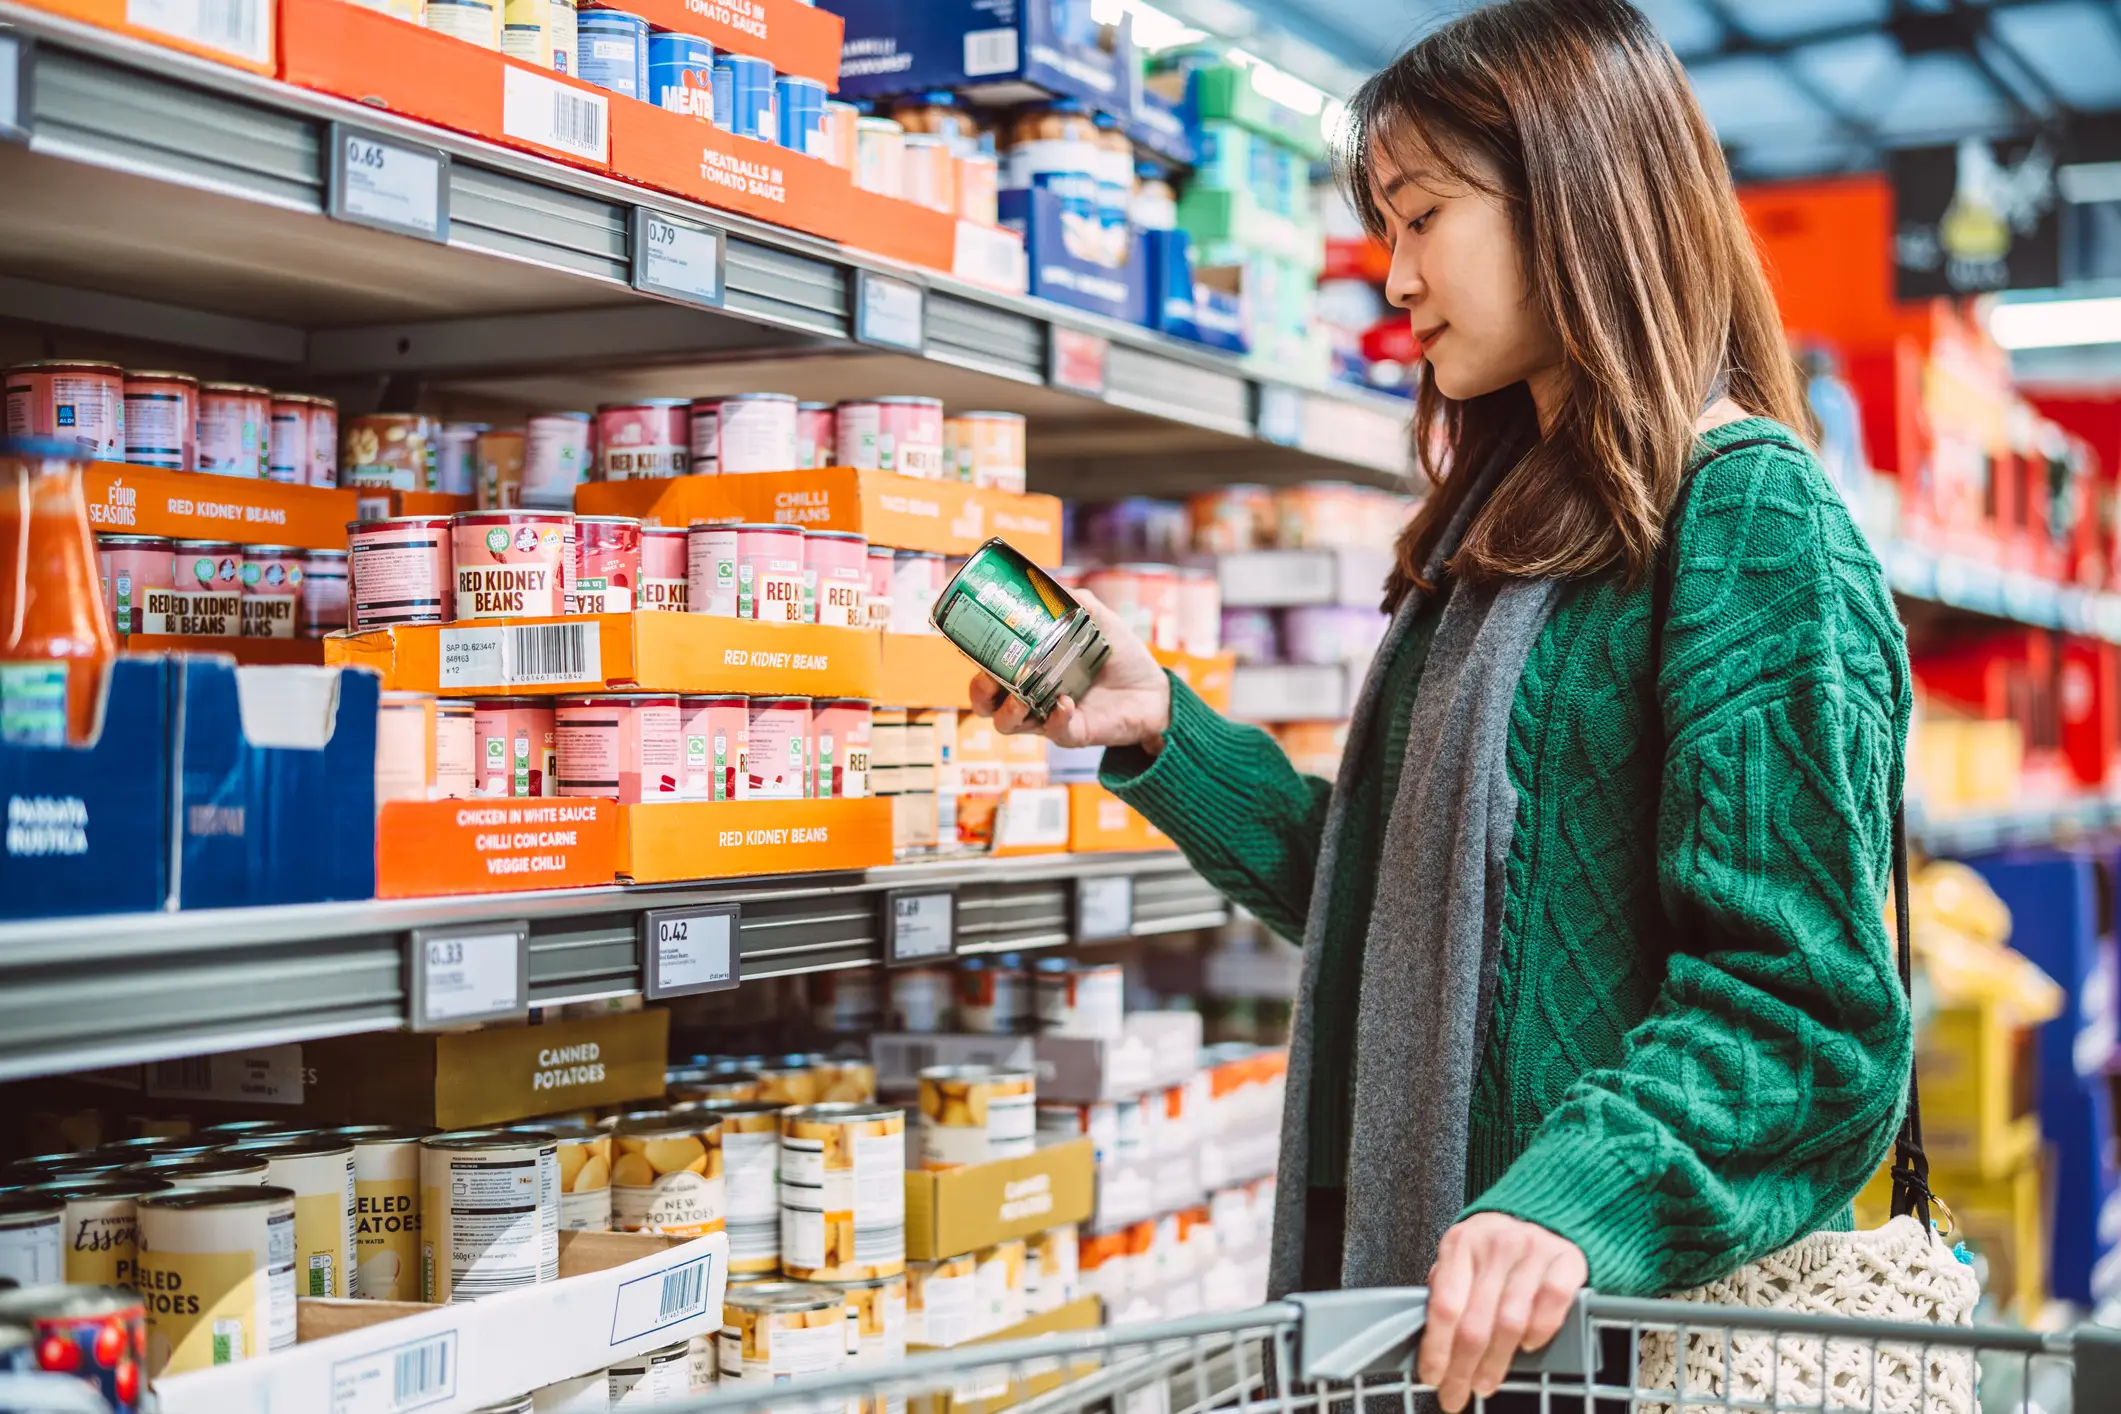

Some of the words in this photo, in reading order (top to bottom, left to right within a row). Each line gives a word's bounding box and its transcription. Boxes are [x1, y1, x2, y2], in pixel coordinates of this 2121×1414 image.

[685, 0, 730, 24] TOMATO
[732, 13, 767, 39] SAUCE
[752, 4, 764, 21] IN
[349, 142, 384, 169] 0.65
[703, 149, 769, 179] MEATBALLS
[770, 168, 783, 185] IN
[700, 164, 746, 193] TOMATO
[748, 180, 786, 203] SAUCE
[649, 223, 675, 245] 0.79
[109, 486, 136, 507] FOUR
[775, 491, 829, 508] CHILLI
[89, 504, 136, 526] SEASONS
[168, 498, 194, 515] RED
[197, 501, 244, 521] KIDNEY
[246, 507, 287, 525] BEANS
[774, 508, 831, 524] BEANS
[460, 572, 482, 592] RED
[485, 571, 546, 591] KIDNEY
[766, 582, 791, 601] RED
[149, 595, 169, 613] RED
[194, 597, 239, 616] KIDNEY
[475, 592, 524, 612] BEANS
[829, 588, 852, 607] RED
[181, 617, 226, 635] BEANS
[446, 644, 460, 652] SAP
[471, 642, 496, 650] 623447
[446, 655, 470, 663] 846163
[724, 650, 748, 666] RED
[750, 652, 791, 669] KIDNEY
[792, 654, 828, 671] BEANS
[554, 672, 583, 681] 145842
[456, 809, 507, 827] CHICKEN
[509, 809, 521, 825] IN
[523, 807, 557, 824] WHITE
[558, 807, 597, 822] SAUCE
[475, 834, 511, 851] CHILLI
[513, 833, 537, 849] CON
[539, 831, 577, 847] CARNE
[719, 831, 743, 847] RED
[746, 829, 789, 845] KIDNEY
[791, 827, 828, 843] BEANS
[487, 857, 530, 875] VEGGIE
[531, 855, 566, 872] CHILLI
[661, 922, 687, 942] 0.42
[431, 942, 463, 965] 0.33
[539, 1042, 600, 1067] CANNED
[533, 1063, 605, 1091] POTATOES
[358, 1196, 411, 1213] ELED
[665, 1199, 697, 1210] NEW
[356, 1214, 422, 1234] ATOES
[646, 1207, 714, 1225] POTATOES
[452, 1252, 467, 1262] 560g
